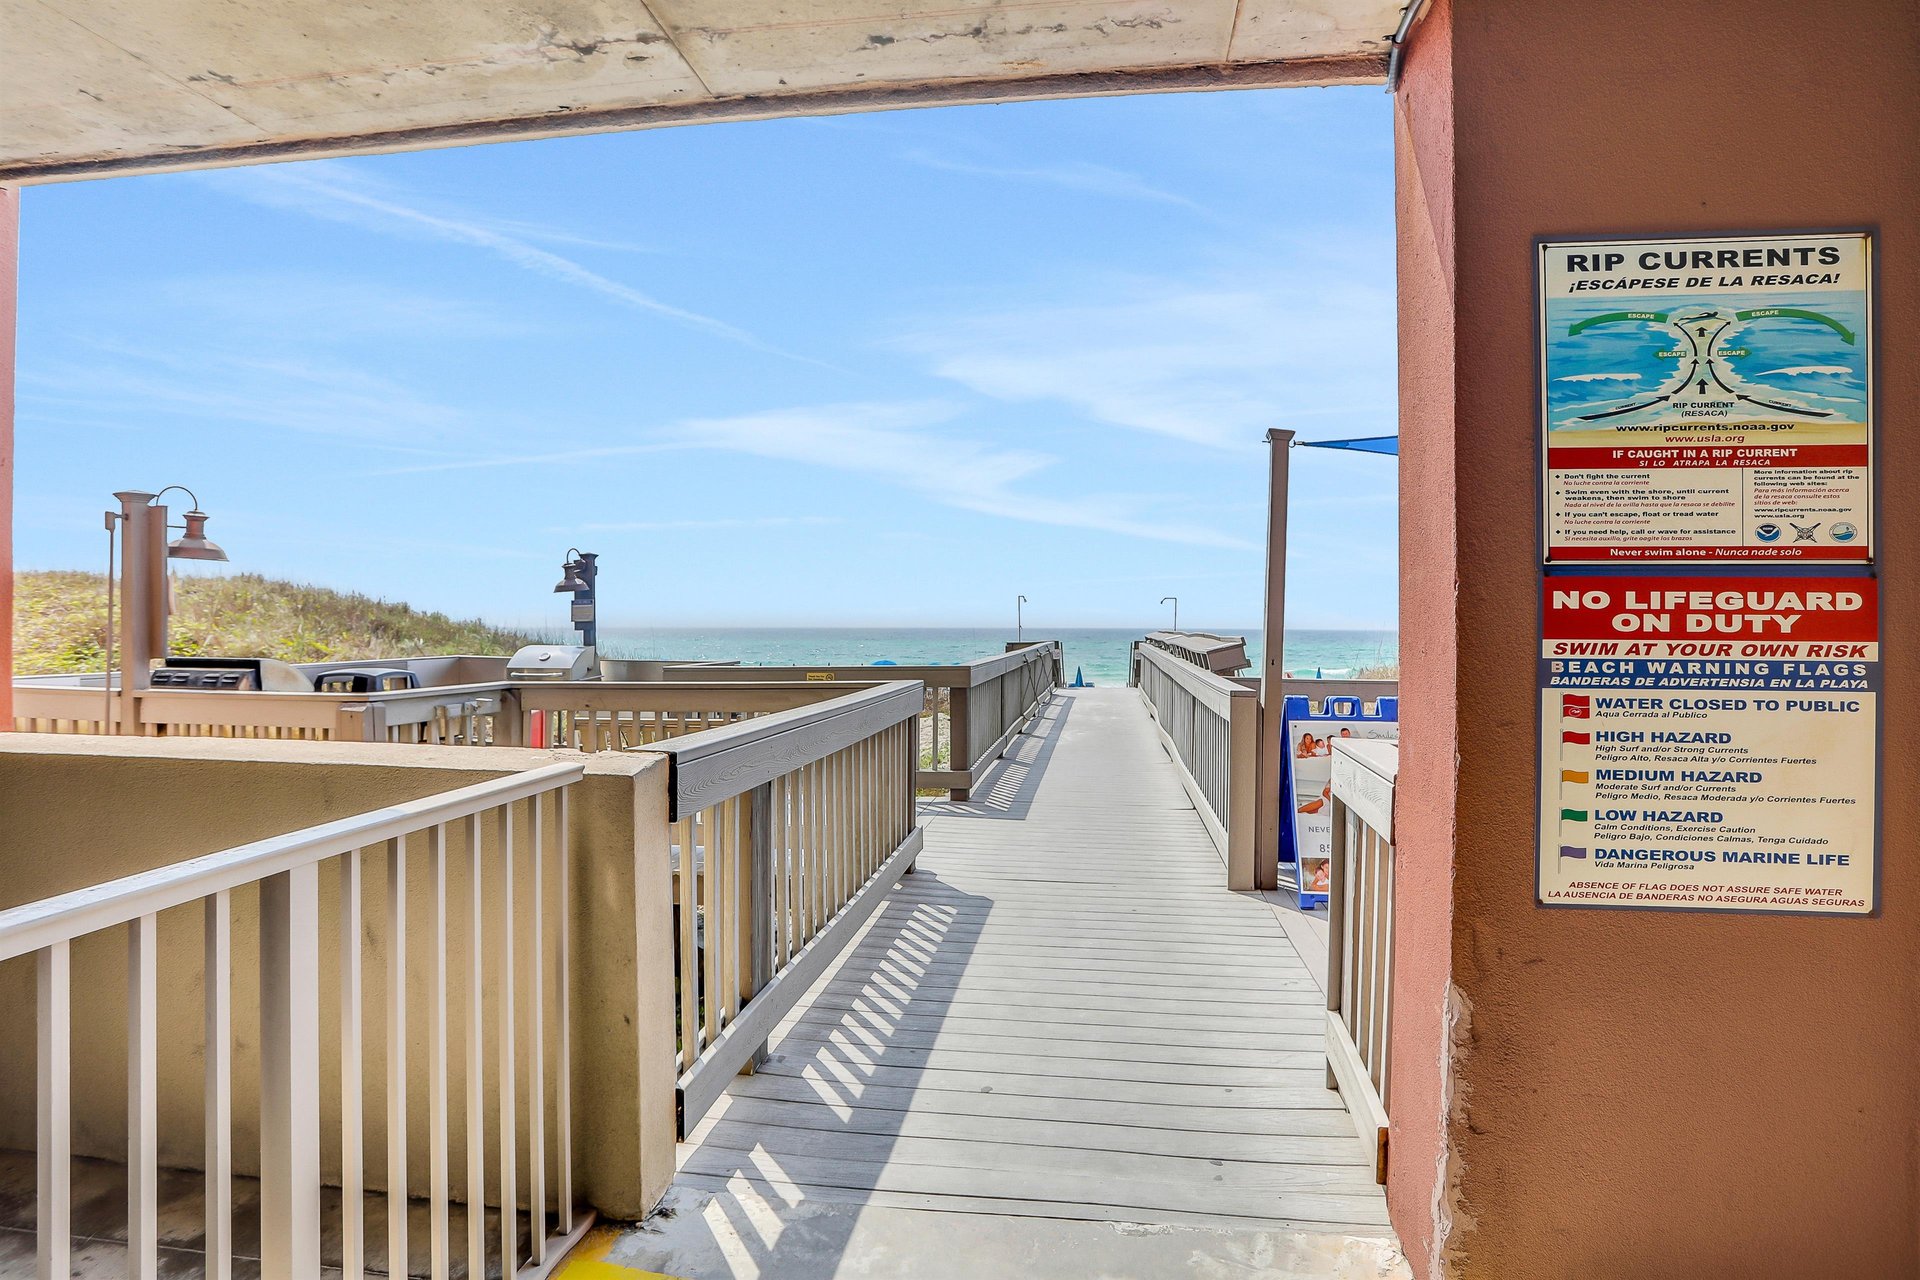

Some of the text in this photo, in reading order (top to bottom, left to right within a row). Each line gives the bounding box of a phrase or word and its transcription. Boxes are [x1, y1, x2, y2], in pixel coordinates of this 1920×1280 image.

[1567, 247, 1840, 272] RIP CURRENTS
[1569, 273, 1841, 293] ¡ESCÁPESE DE LA RESACA!
[1690, 401, 1735, 409] CURRENT
[1681, 410, 1728, 418] (RESACA)
[1616, 423, 1795, 433] www.ripcurrents.noaa.gov
[1665, 434, 1745, 444] www.usla.org
[1613, 448, 1798, 458] IF CAUGHT IN A RIP CURRENT
[1610, 548, 1802, 556] Never swim alone Nunca nade solo
[1553, 591, 1863, 611] NO LIFEGUARD
[1612, 613, 1802, 633] ON DUTY
[1553, 642, 1869, 658] SWIM AT YOUR OWN RISK
[1551, 661, 1866, 676] BEACH WARNING FLAGS
[1550, 676, 1868, 689] BANDERAS DE ADVERTENSIA EN LA PLAYA
[1595, 698, 1860, 712] WATER CLOSED TO PUBLIC
[1622, 710, 1659, 718] Cerrada
[1672, 711, 1708, 719] Publico
[1596, 731, 1731, 744] HIGH HAZARD
[1595, 745, 1617, 753] High
[1673, 746, 1705, 754] Strong
[1708, 746, 1748, 754] Currents
[1595, 754, 1628, 762] Peligro
[1629, 754, 1651, 762] Alto,
[1711, 756, 1726, 764] y/o
[1729, 756, 1778, 764] Corrientes
[1780, 757, 1817, 765] Fuertes
[1596, 769, 1762, 783] MEDIUM HAZARD
[1695, 784, 1736, 792] Currents
[1595, 792, 1628, 801] Peligro
[1630, 793, 1661, 801] Medio,
[1663, 793, 1698, 801] Resaca
[1700, 794, 1747, 802] Moderada
[1749, 795, 1764, 804] y/o
[1767, 795, 1817, 803] Corrientes
[1595, 809, 1723, 823] LOW HAZARD
[1620, 824, 1673, 832] Conditions,
[1719, 826, 1756, 834] Caution
[1594, 832, 1829, 845] Peligro Bajo, Condiciones Calmas, Tenga Cuidado
[1595, 848, 1850, 866] DANGEROUS MARINE LIFE
[1617, 861, 1648, 869] Marina
[1650, 862, 1695, 871] Peligrosa
[1568, 881, 1619, 890] ABSENCE
[1622, 882, 1637, 890] OF
[1638, 883, 1667, 891] FLAG
[1669, 884, 1699, 892] DOES
[1726, 886, 1771, 894] ASSURE
[1773, 887, 1802, 895] SAFE
[1805, 888, 1843, 896] WATER
[1548, 890, 1561, 898] LA
[1563, 891, 1616, 899] AUSENCIA
[1619, 892, 1634, 900] DE
[1636, 893, 1695, 901] BANDERAS
[1715, 895, 1768, 903] ASEGURA
[1769, 897, 1809, 905] AGUAS
[1811, 898, 1865, 907] SEGURAS
